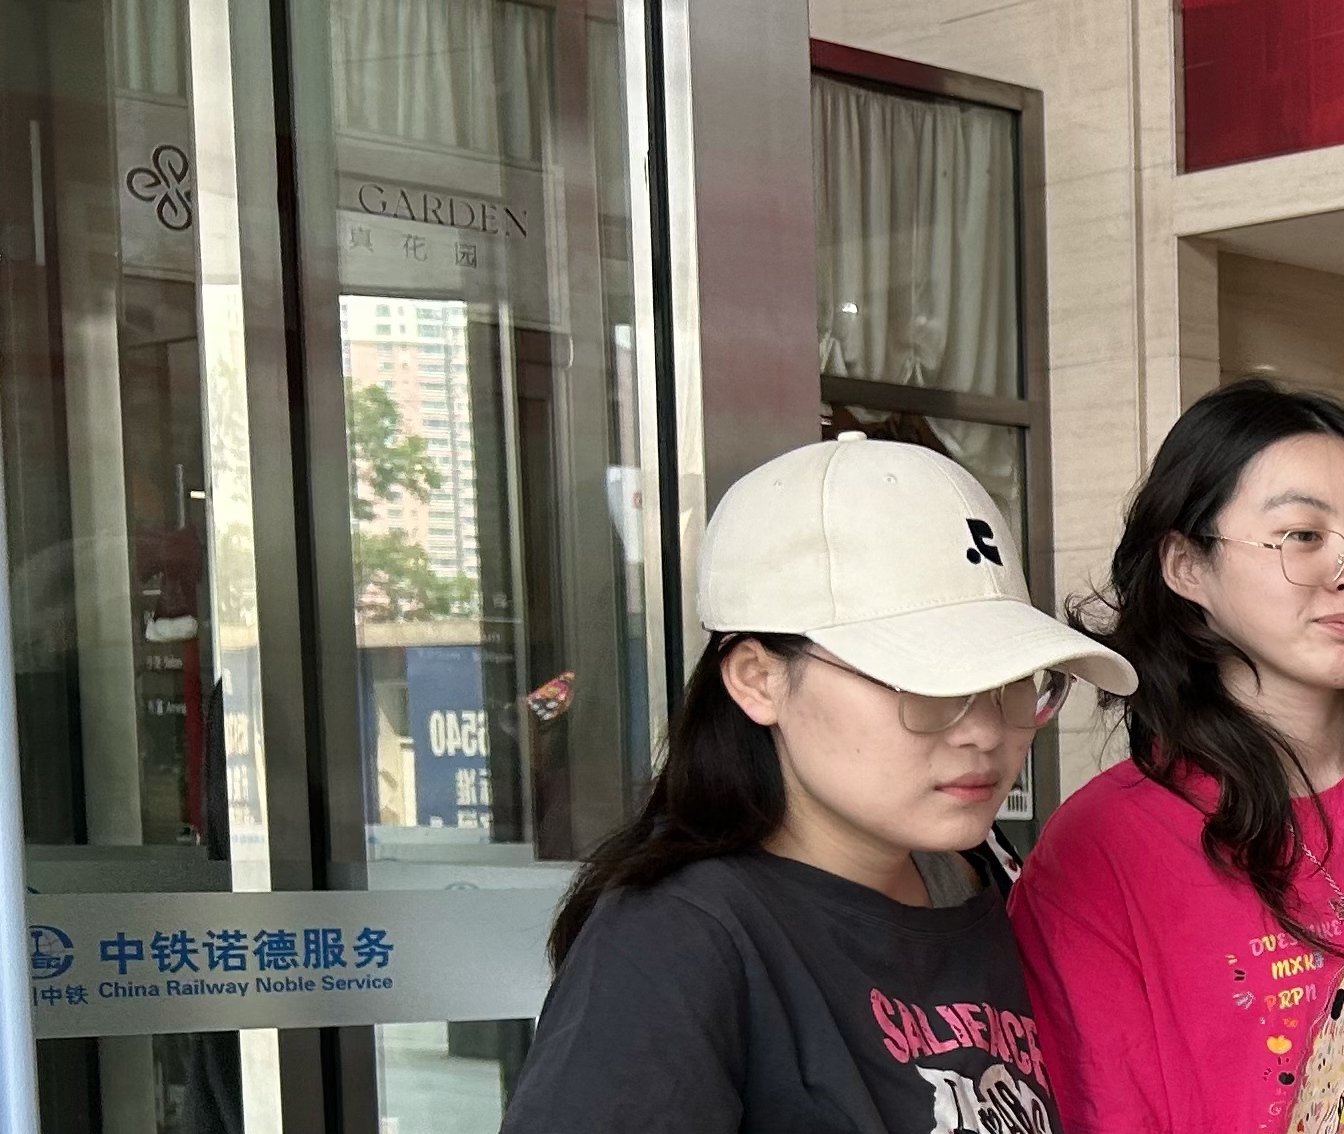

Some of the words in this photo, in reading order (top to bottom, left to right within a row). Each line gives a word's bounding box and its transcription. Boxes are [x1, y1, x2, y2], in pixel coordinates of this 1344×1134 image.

[358, 183, 528, 238] GARDEN
[99, 926, 395, 975] 中铁诺德服务
[31, 983, 89, 1007] 中铁
[99, 981, 160, 998] China
[166, 978, 249, 997] Railway
[256, 976, 316, 993] Noble
[321, 974, 393, 991] Service
